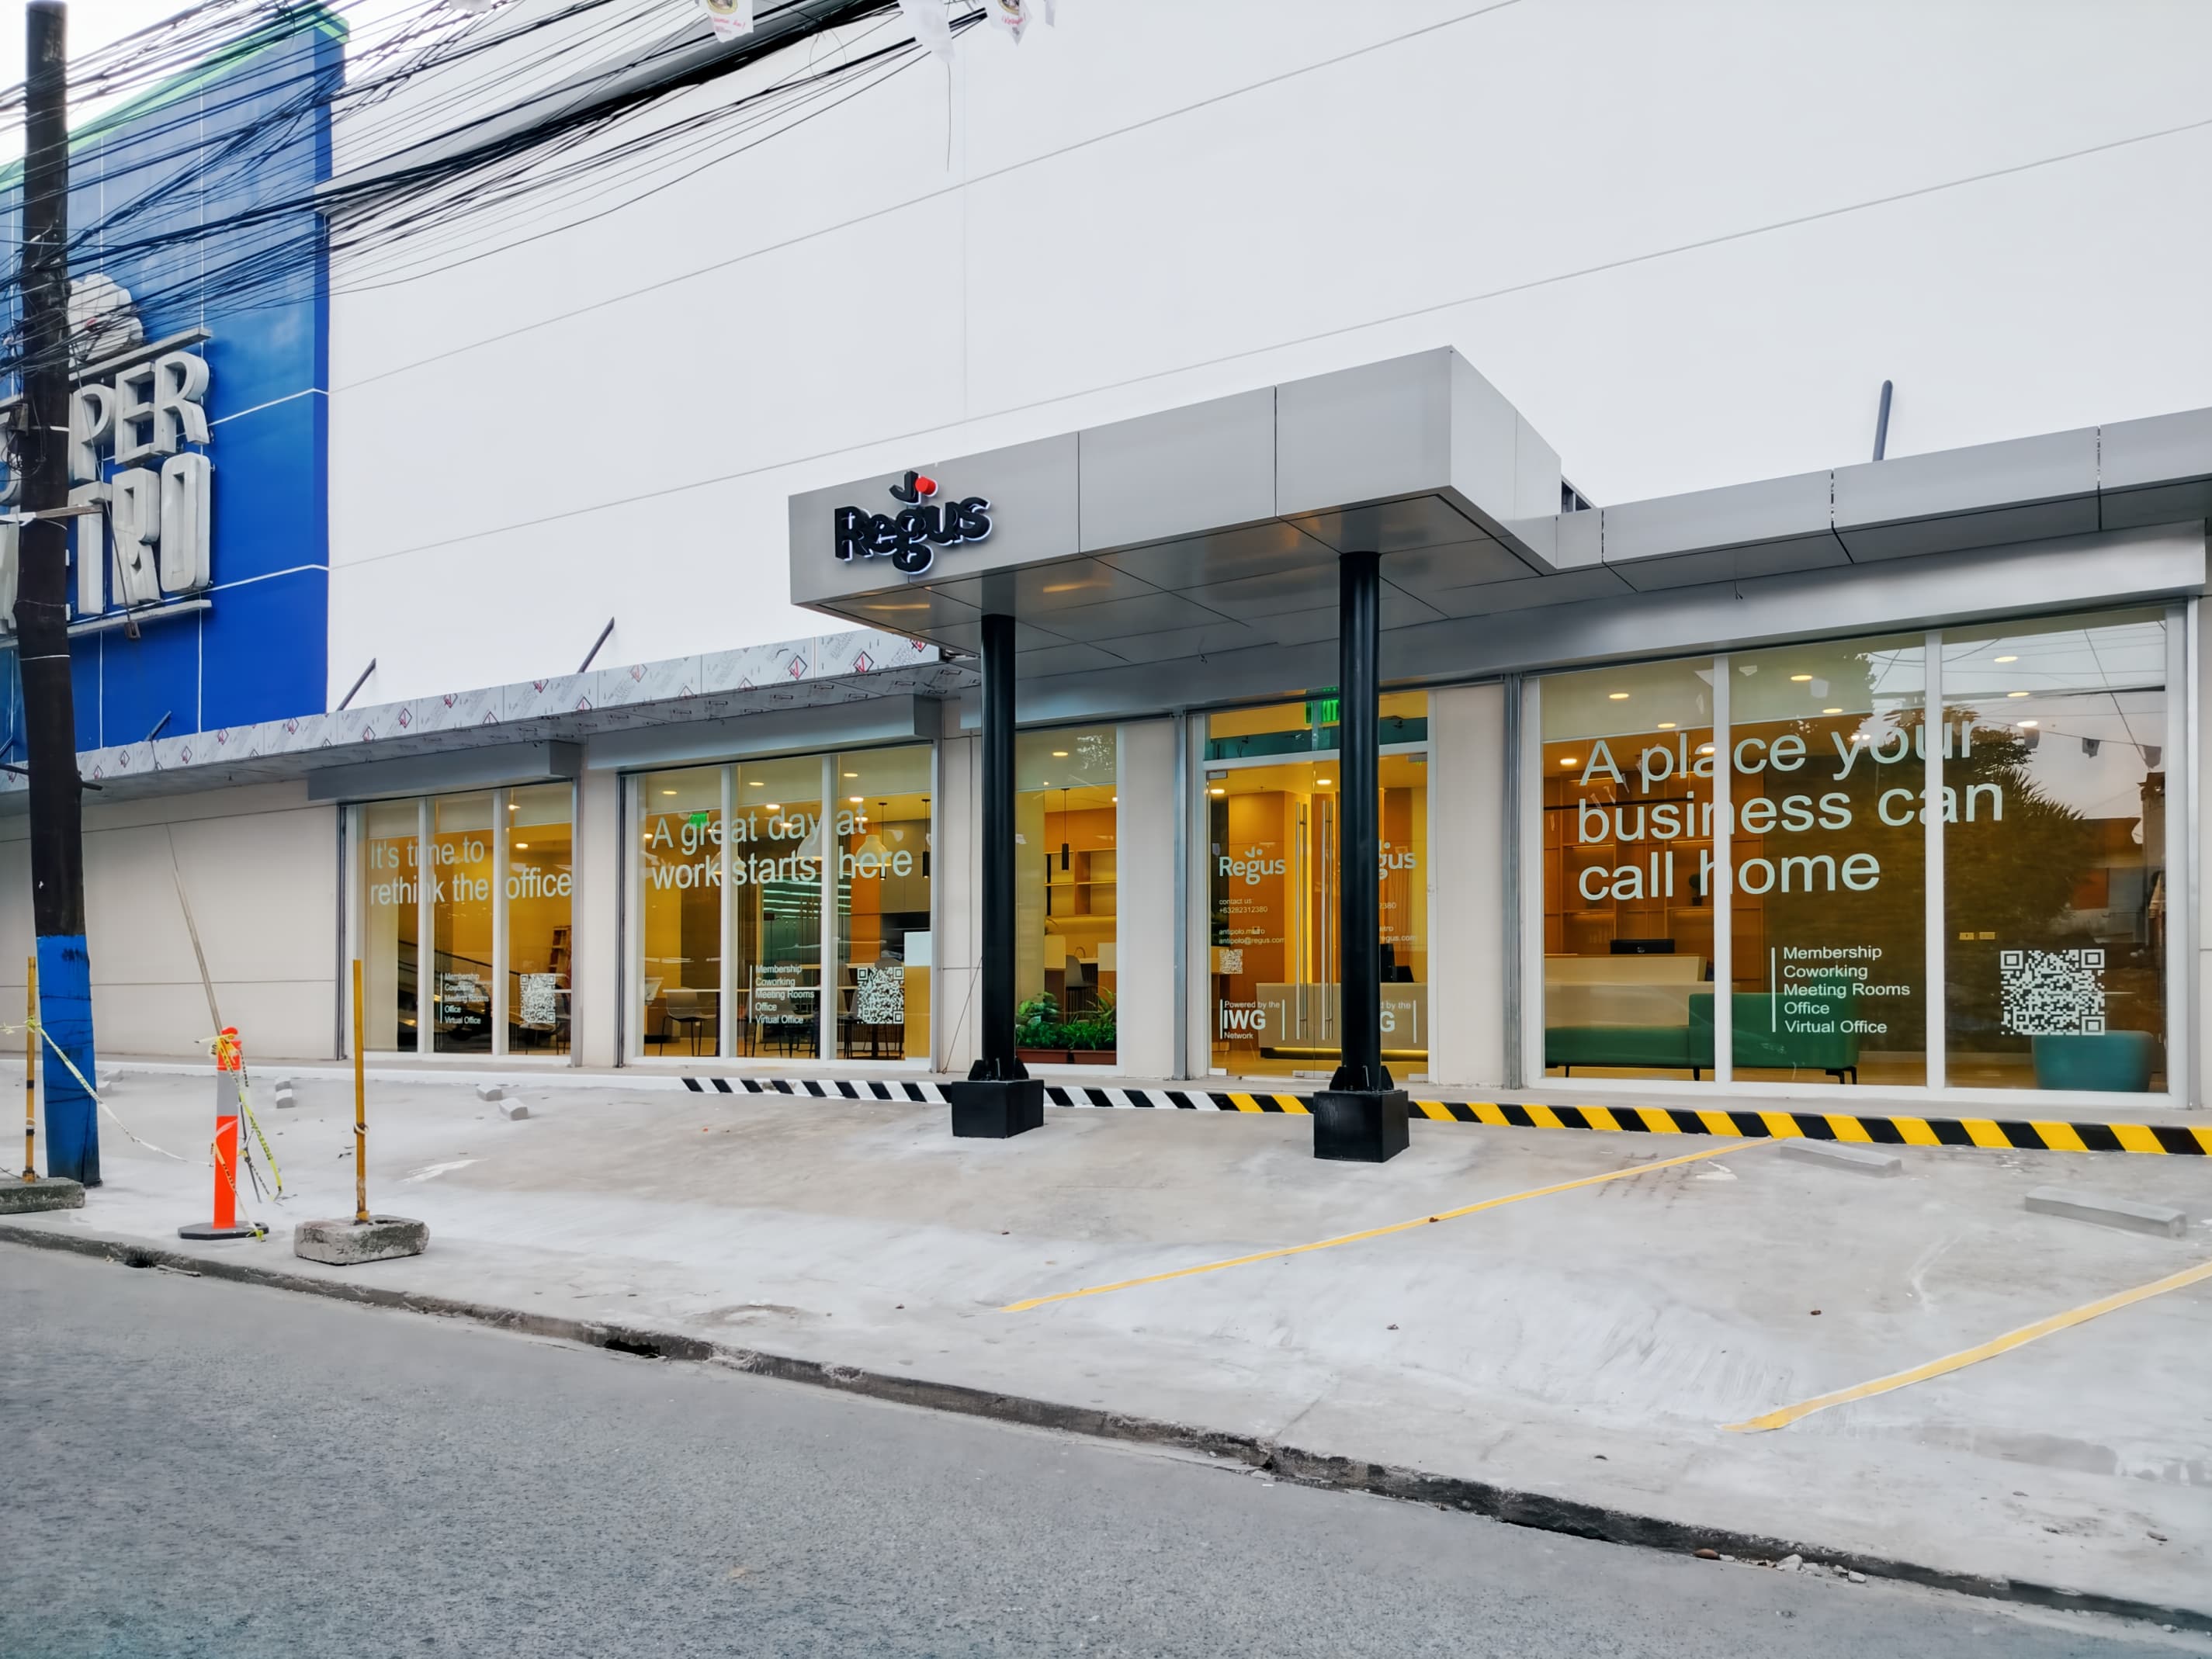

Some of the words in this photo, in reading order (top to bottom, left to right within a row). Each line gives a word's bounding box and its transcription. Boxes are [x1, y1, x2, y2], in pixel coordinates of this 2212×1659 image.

[834, 496, 993, 575] Regus
[1579, 739, 1624, 786] A
[1641, 733, 1807, 795] place
[1830, 720, 1978, 781] your
[1578, 790, 1853, 843] business
[1877, 783, 2003, 827] can
[651, 817, 674, 850] A
[680, 810, 758, 855] great
[767, 806, 824, 845] day
[836, 804, 867, 836] at
[370, 840, 400, 870] It's
[407, 840, 455, 868] time
[463, 836, 485, 864] to
[651, 855, 721, 890] work
[732, 850, 816, 885] starts
[837, 845, 914, 880] here
[1219, 856, 1286, 885] Regus
[1379, 852, 1416, 881] gus
[1579, 850, 1673, 901] call
[1699, 849, 1881, 897] home
[452, 872, 489, 902] the
[505, 867, 573, 900] office
[1219, 906, 1268, 914] +63282312380
[1219, 937, 1285, 946] antipolo@regus.com
[1783, 945, 1883, 961] Membership
[755, 965, 803, 975] Membership
[1784, 965, 1869, 981] Coworking
[755, 977, 796, 988] Coworking
[1784, 983, 1847, 999] Meeting
[1852, 982, 1912, 996] Rooms
[755, 989, 785, 1001] Meeting
[787, 989, 815, 999] Rooms
[444, 1005, 462, 1013] Office
[755, 1002, 778, 1012] Office
[1257, 1001, 1267, 1010] by
[1398, 1001, 1411, 1010] the
[1784, 1001, 1830, 1015] Office
[444, 1016, 463, 1024] Virtual
[464, 1016, 481, 1024] Office
[755, 1014, 779, 1024] Virtual
[781, 1014, 804, 1024] Office
[1223, 1010, 1267, 1030] IWG
[1785, 1020, 1836, 1034] Virtual
[1839, 1020, 1888, 1034] Office
